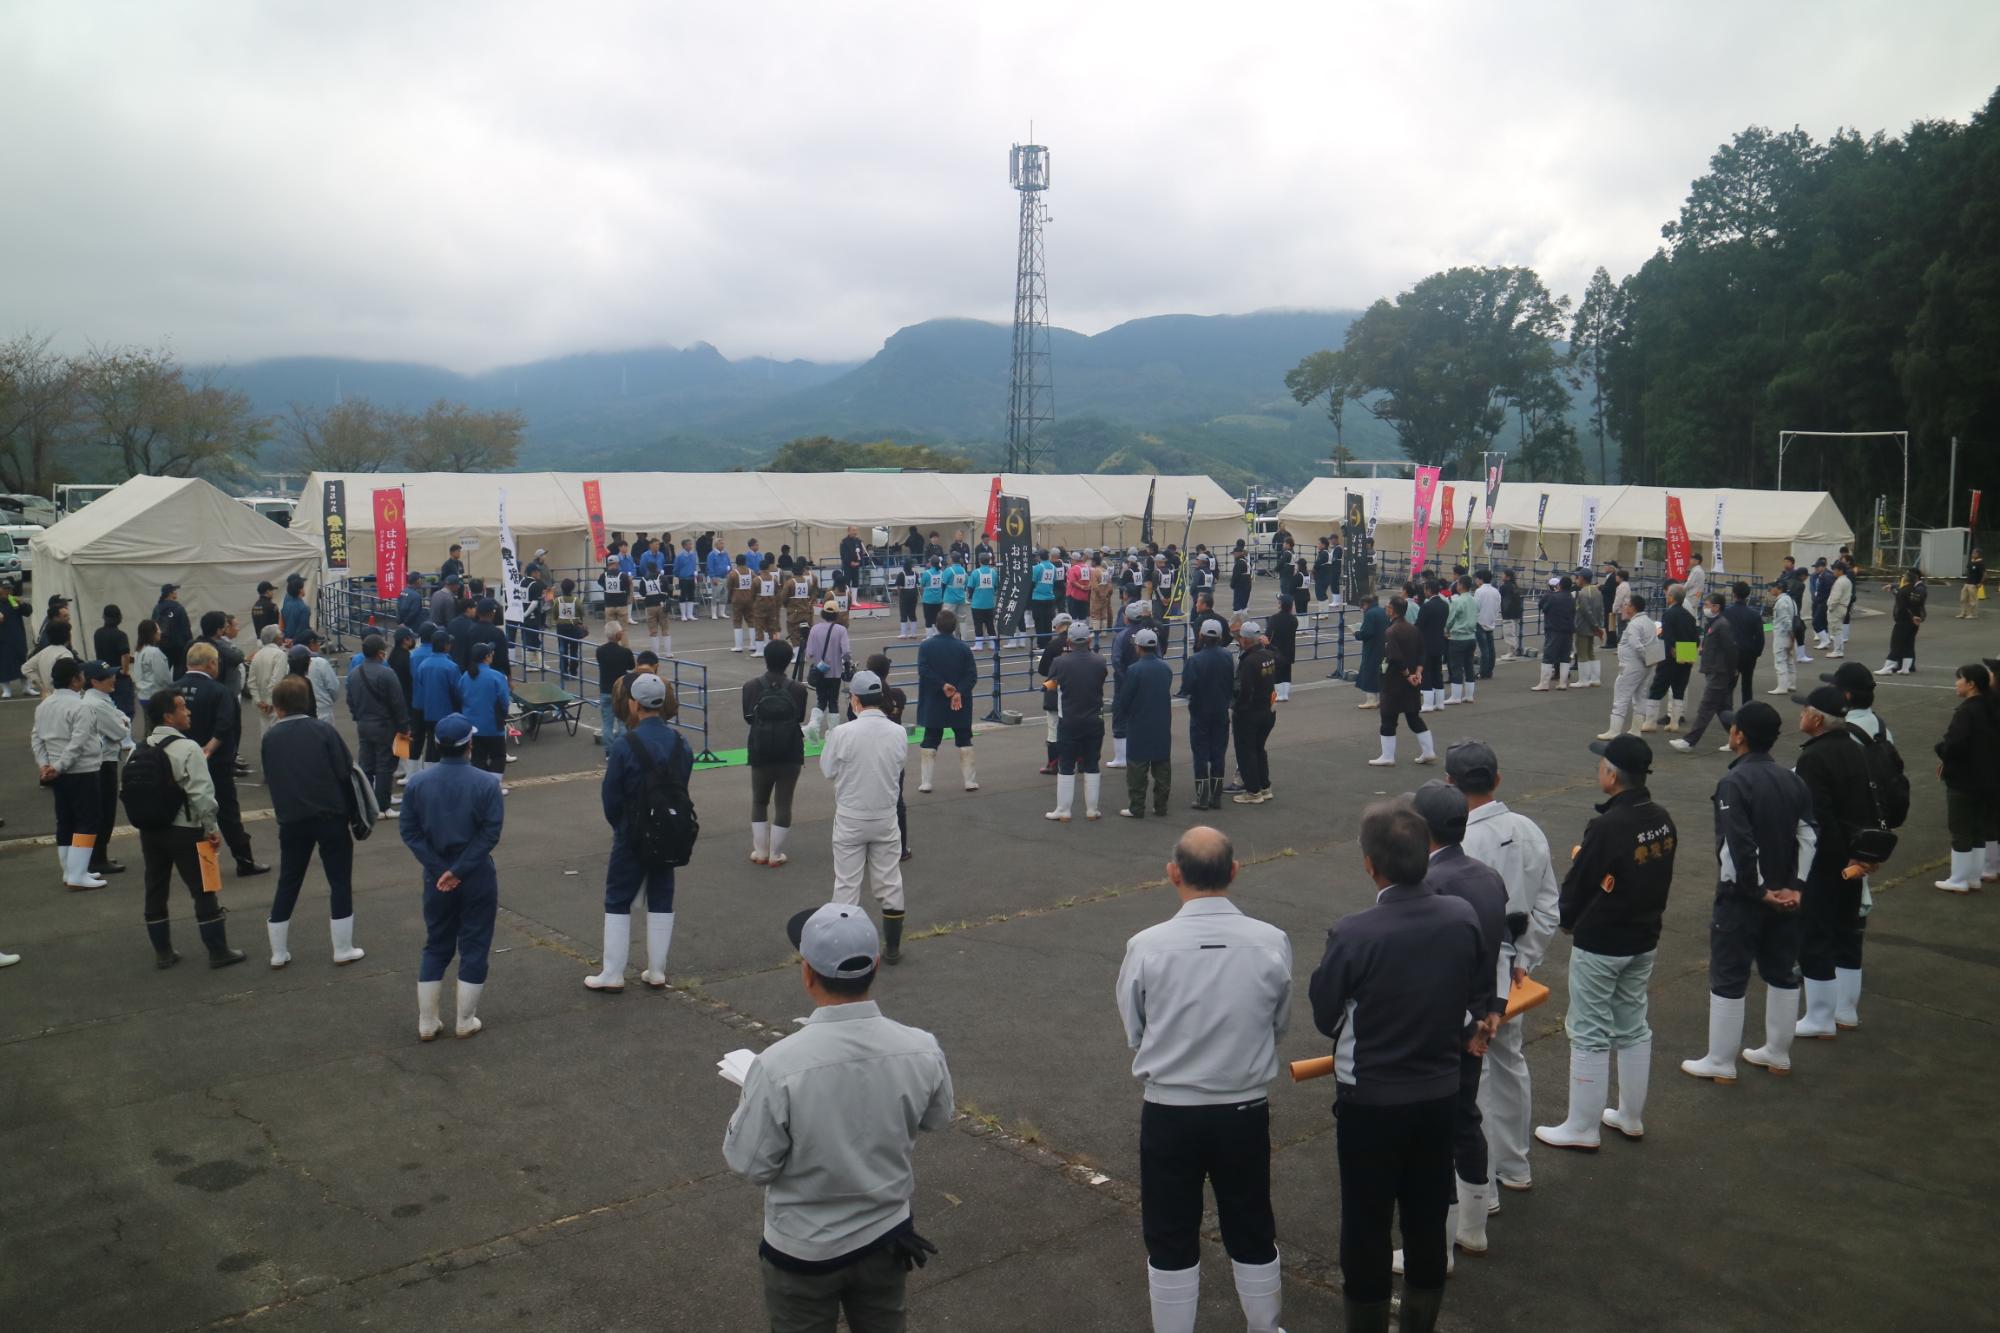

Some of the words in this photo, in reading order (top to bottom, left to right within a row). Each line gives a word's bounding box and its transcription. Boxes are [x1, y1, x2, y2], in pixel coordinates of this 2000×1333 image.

[607, 581, 618, 590] 29
[1004, 544, 1022, 626] おおいた和牛
[797, 586, 806, 595] 24
